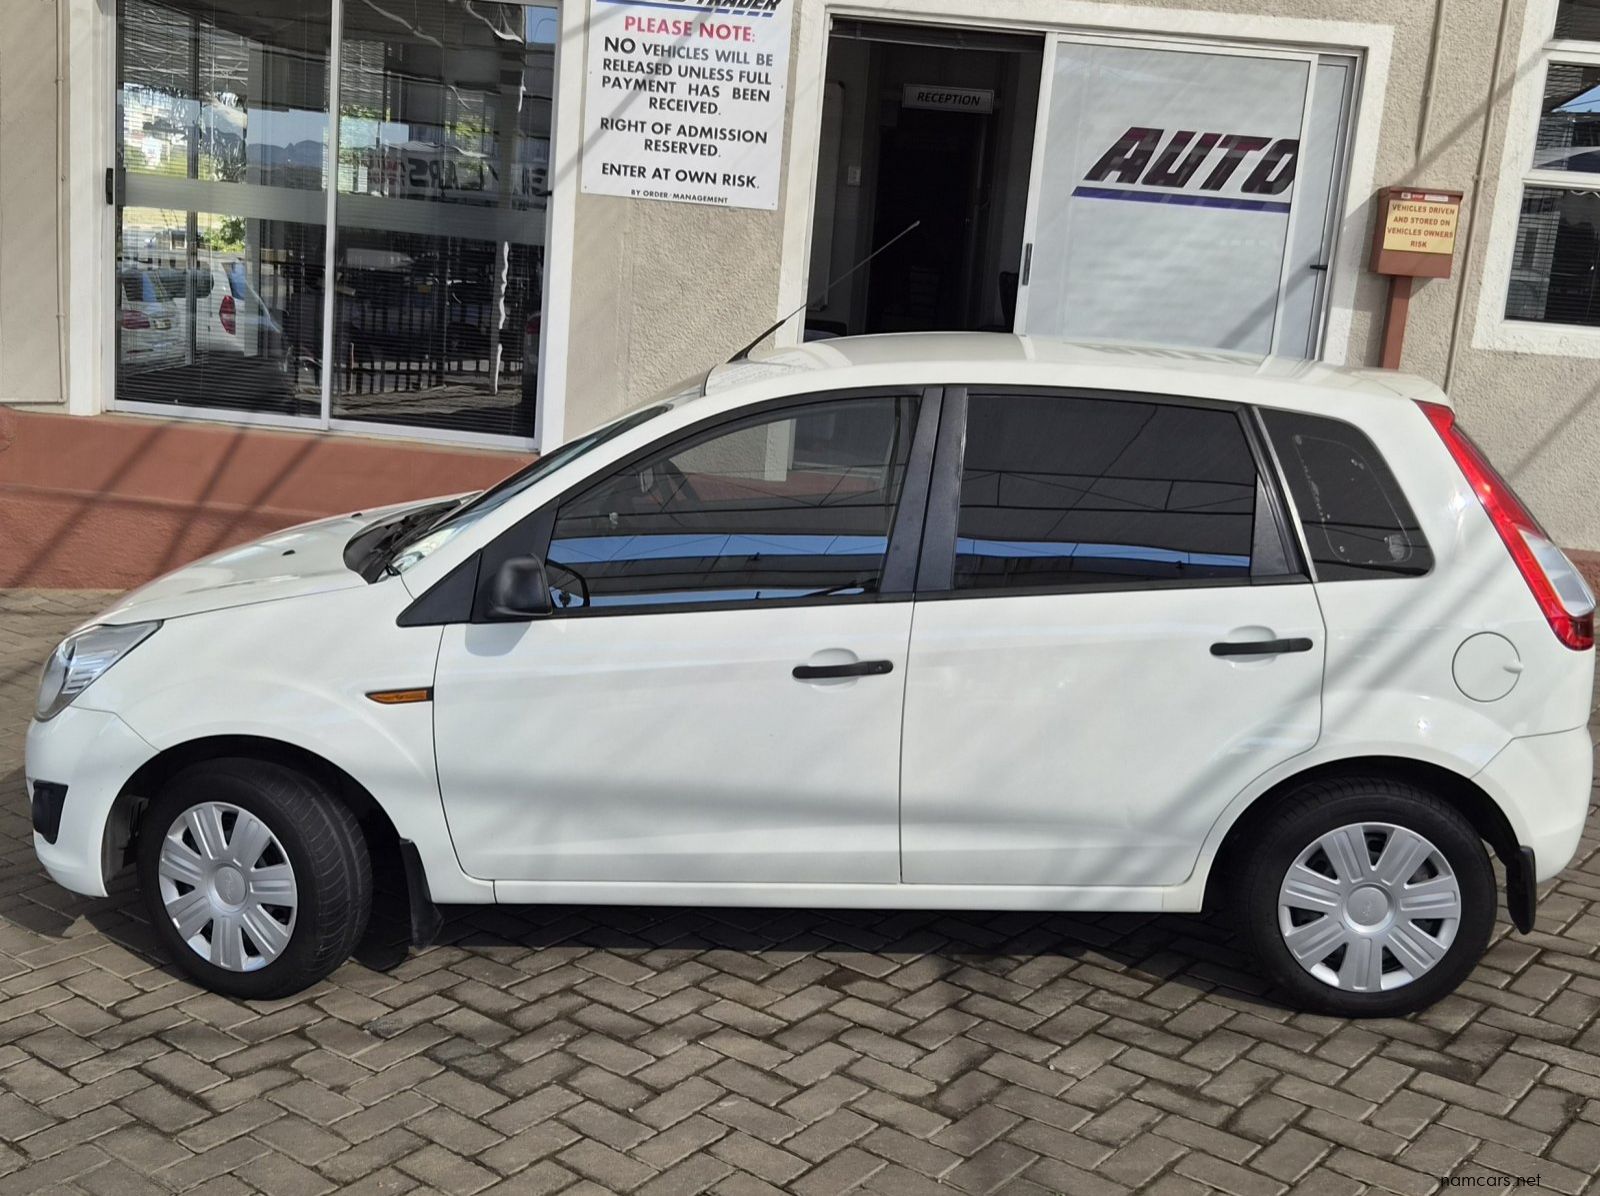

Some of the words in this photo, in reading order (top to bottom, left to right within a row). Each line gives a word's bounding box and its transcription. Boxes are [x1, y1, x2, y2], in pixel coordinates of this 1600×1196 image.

[697, 0, 781, 11] ADER
[624, 16, 692, 36] PLEASE
[699, 23, 756, 42] NOTE:
[604, 36, 636, 54] NO
[642, 43, 709, 61] VEHICLES
[715, 49, 750, 65] WILL
[756, 53, 773, 67] BE
[603, 58, 673, 76] RELEASED
[678, 65, 734, 82] UNLESS
[739, 70, 772, 85] FULL
[602, 75, 677, 94] PAYMENT
[688, 83, 720, 98] HAS
[732, 87, 770, 102] BEEN
[649, 97, 721, 115] RECEIVED.
[917, 91, 981, 106] RECEPTION
[600, 117, 647, 133] RIGHT
[651, 122, 672, 136] OF
[676, 125, 768, 144] ADMISSION
[644, 139, 721, 157] RESERVED.
[1083, 127, 1300, 195] AUTO
[602, 162, 647, 179] ENTER
[651, 167, 671, 181] AT
[675, 169, 717, 184] OWN
[722, 173, 760, 189] RISK.
[643, 190, 668, 198] ORDER
[672, 192, 728, 204] MANAGEMENT
[1393, 204, 1426, 212] VEHICLES
[1429, 207, 1455, 215] DRIVEN
[1410, 217, 1438, 225] STORED
[1387, 227, 1421, 235] VEHICLES
[1424, 230, 1453, 238] OWNERS
